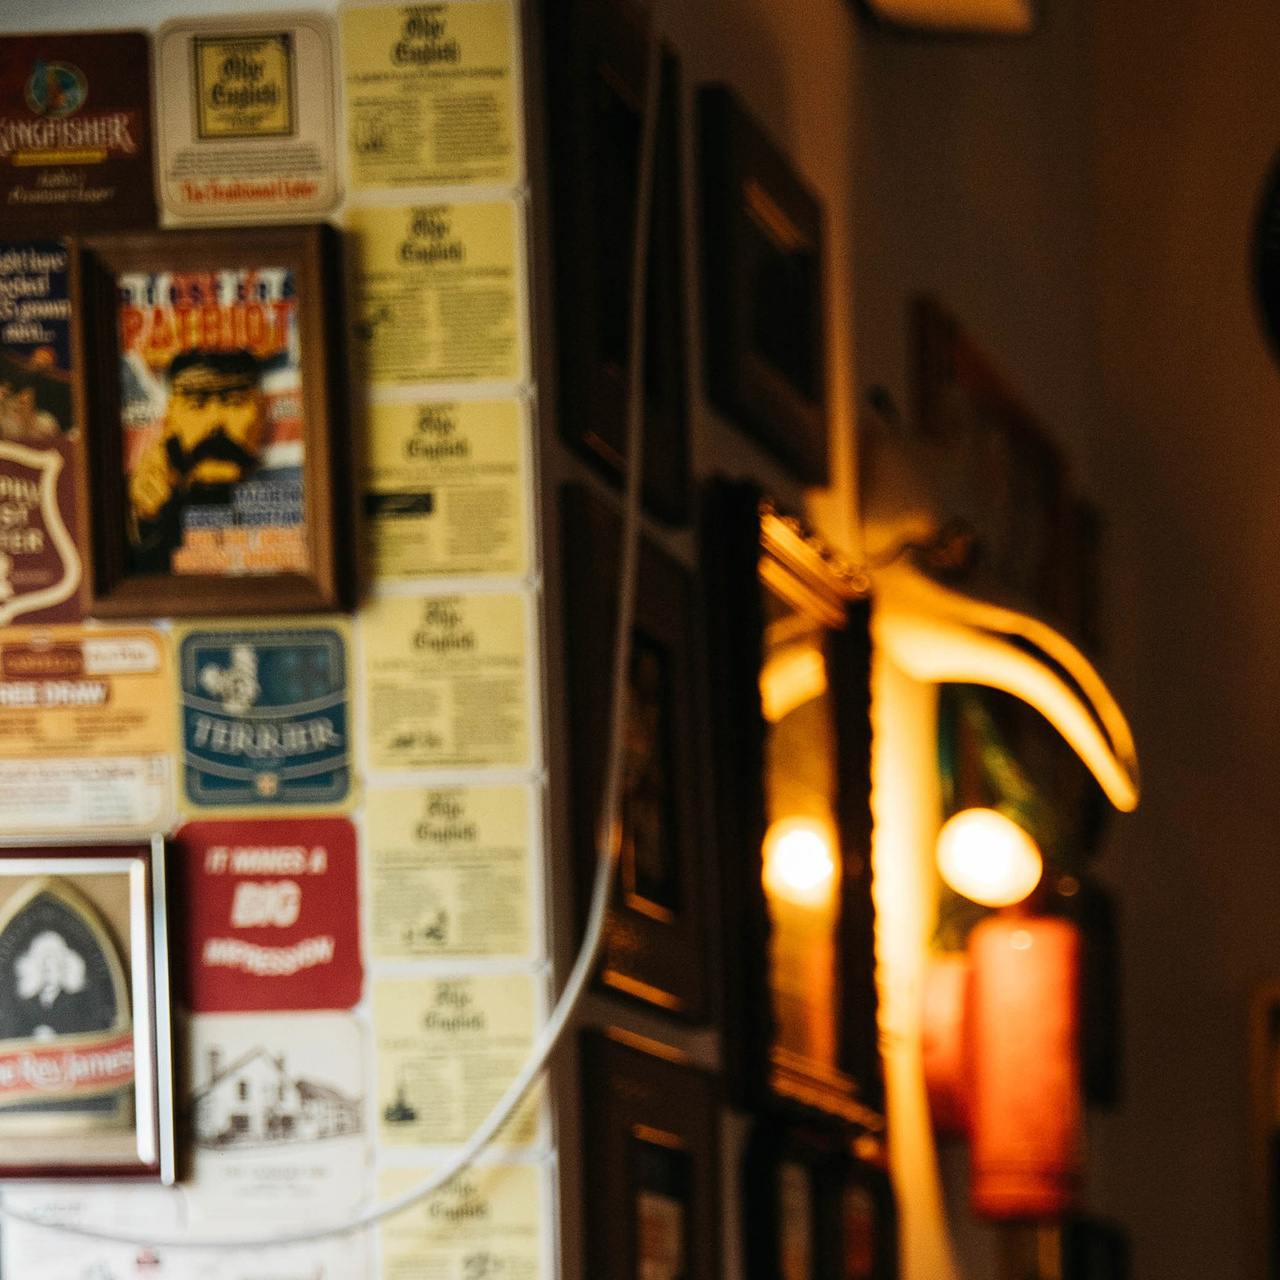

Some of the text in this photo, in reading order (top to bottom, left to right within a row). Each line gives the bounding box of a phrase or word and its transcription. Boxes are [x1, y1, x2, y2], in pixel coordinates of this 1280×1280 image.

[194, 714, 343, 758] TERRIER
[204, 846, 229, 876] IT
[229, 879, 302, 928] BIG
[203, 935, 336, 976] IMPRESSION
